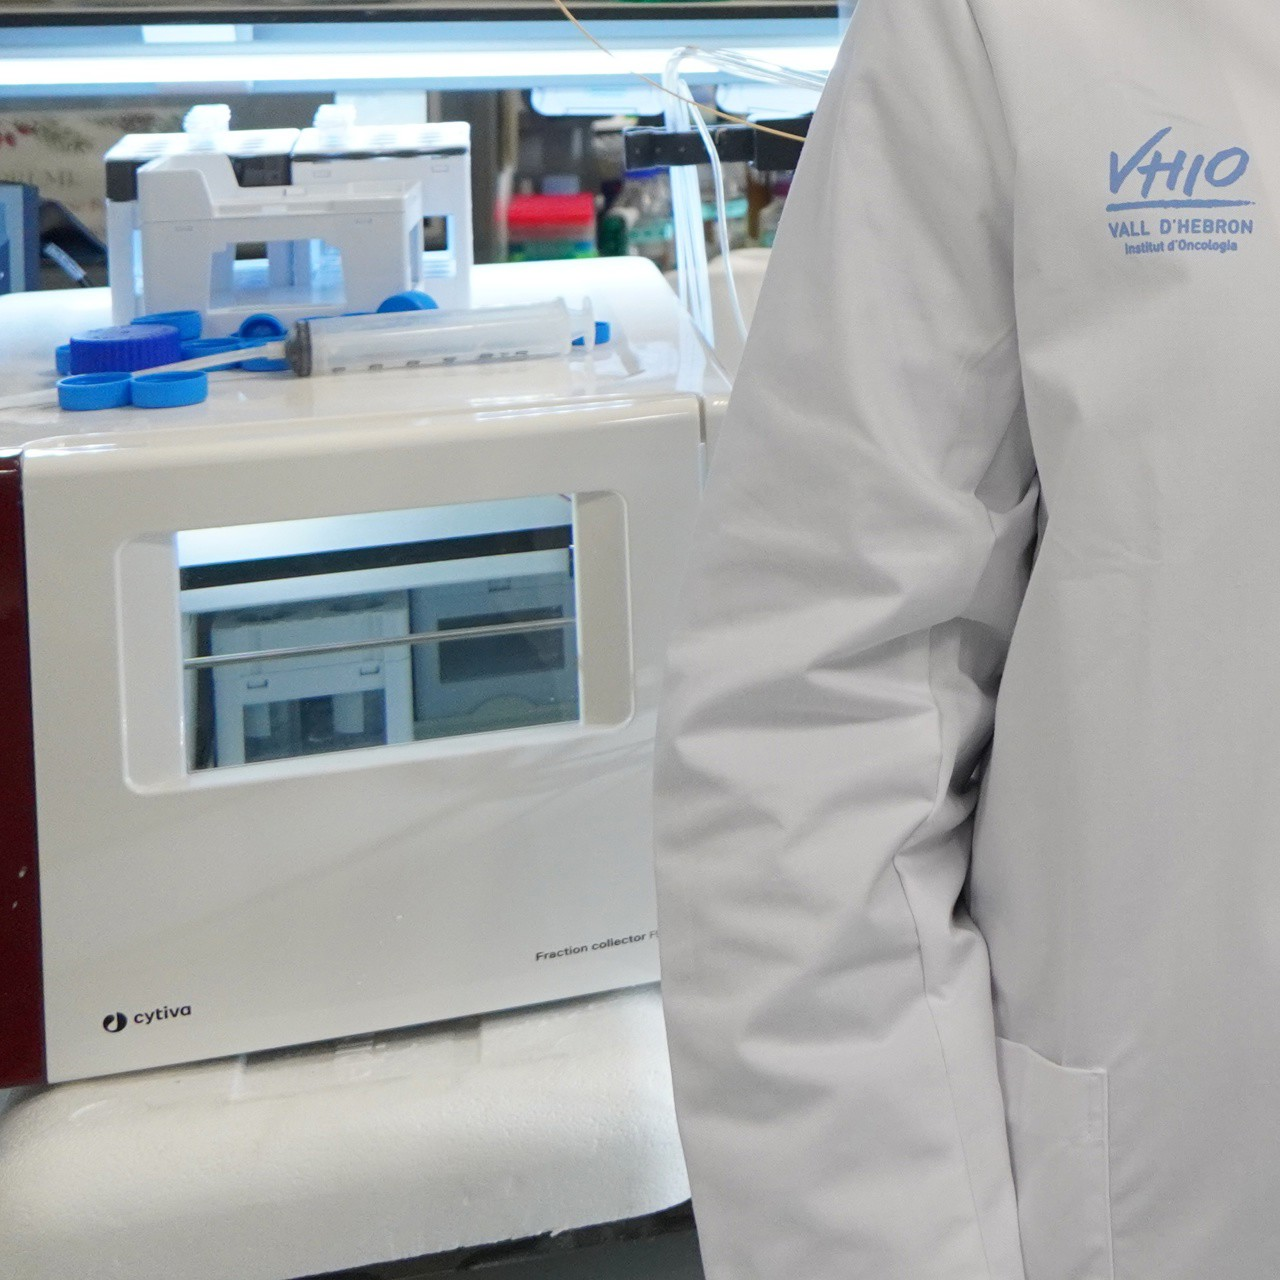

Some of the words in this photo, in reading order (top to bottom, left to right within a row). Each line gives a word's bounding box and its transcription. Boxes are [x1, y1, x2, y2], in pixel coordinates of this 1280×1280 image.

[1109, 126, 1250, 199] VHIO
[1108, 220, 1150, 238] VALL
[1159, 219, 1254, 235] D'HEBRON
[1125, 242, 1165, 255] Institut
[1167, 239, 1238, 254] d'Oncologia
[535, 944, 588, 962] Fraction
[591, 932, 646, 951] collector
[133, 1004, 192, 1026] cytiva
